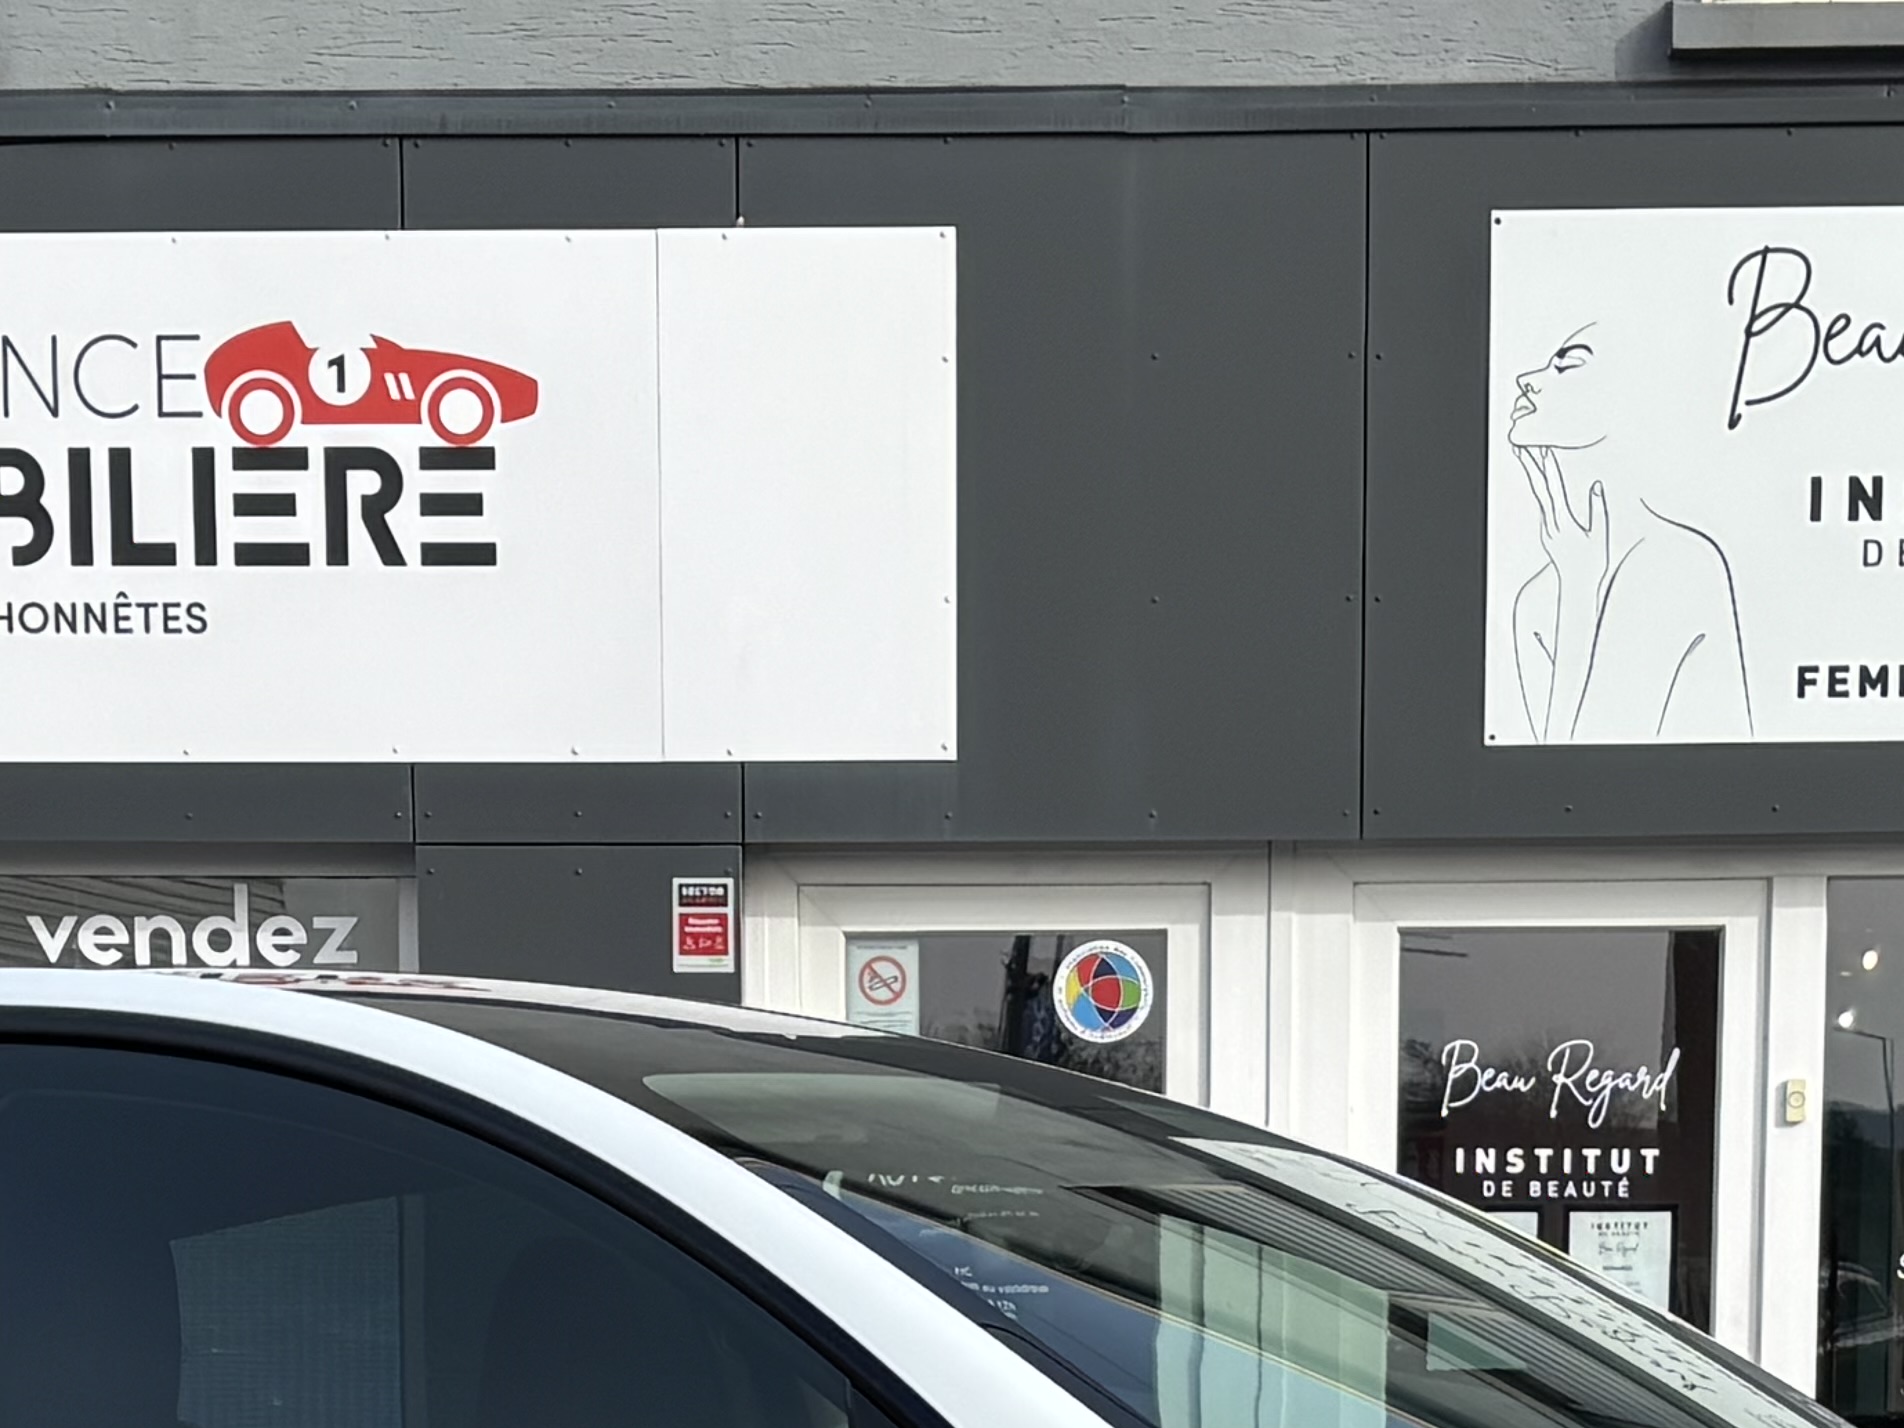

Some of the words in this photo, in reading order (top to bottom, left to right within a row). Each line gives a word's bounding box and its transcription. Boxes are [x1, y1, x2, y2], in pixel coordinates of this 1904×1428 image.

[26, 883, 358, 967] vendez
[1441, 1039, 1536, 1117] Beau
[1547, 1039, 1681, 1128] Regard
[1455, 1147, 1660, 1175] INSTITUT
[1483, 1180, 1513, 1198] DE
[1529, 1174, 1630, 1198] BEAUTÉ
